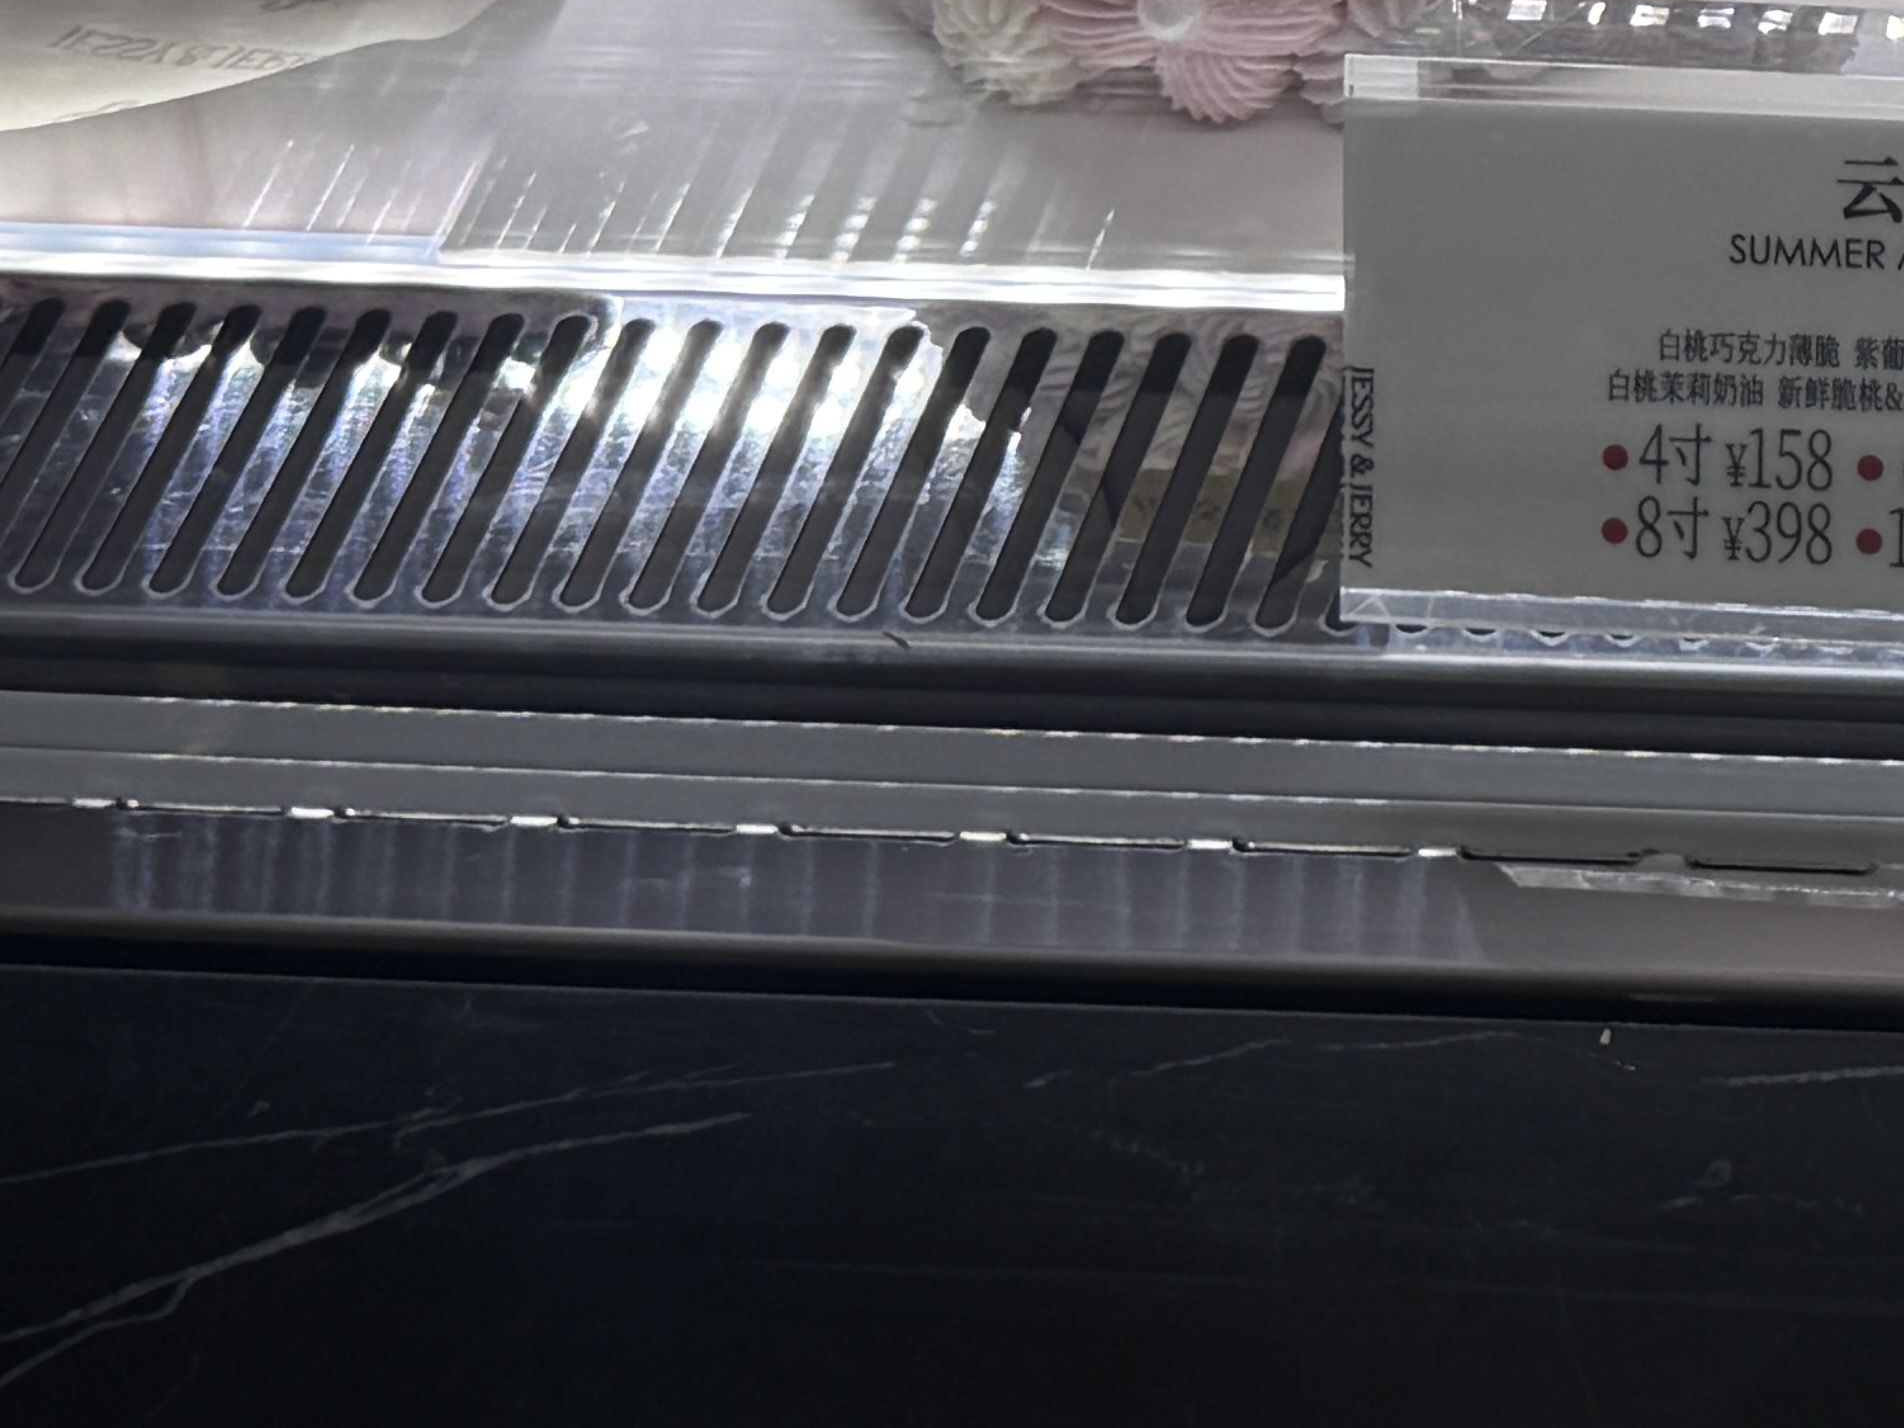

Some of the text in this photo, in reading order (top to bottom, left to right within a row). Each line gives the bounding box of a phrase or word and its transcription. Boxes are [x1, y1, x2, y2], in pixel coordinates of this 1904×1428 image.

[1729, 233, 1886, 271] SUMMER
[1658, 328, 1841, 369] 白桃巧克力薄脆
[1608, 368, 1765, 409] 白桃茉莉奶油
[1345, 366, 1375, 569] JESSY & JERRY
